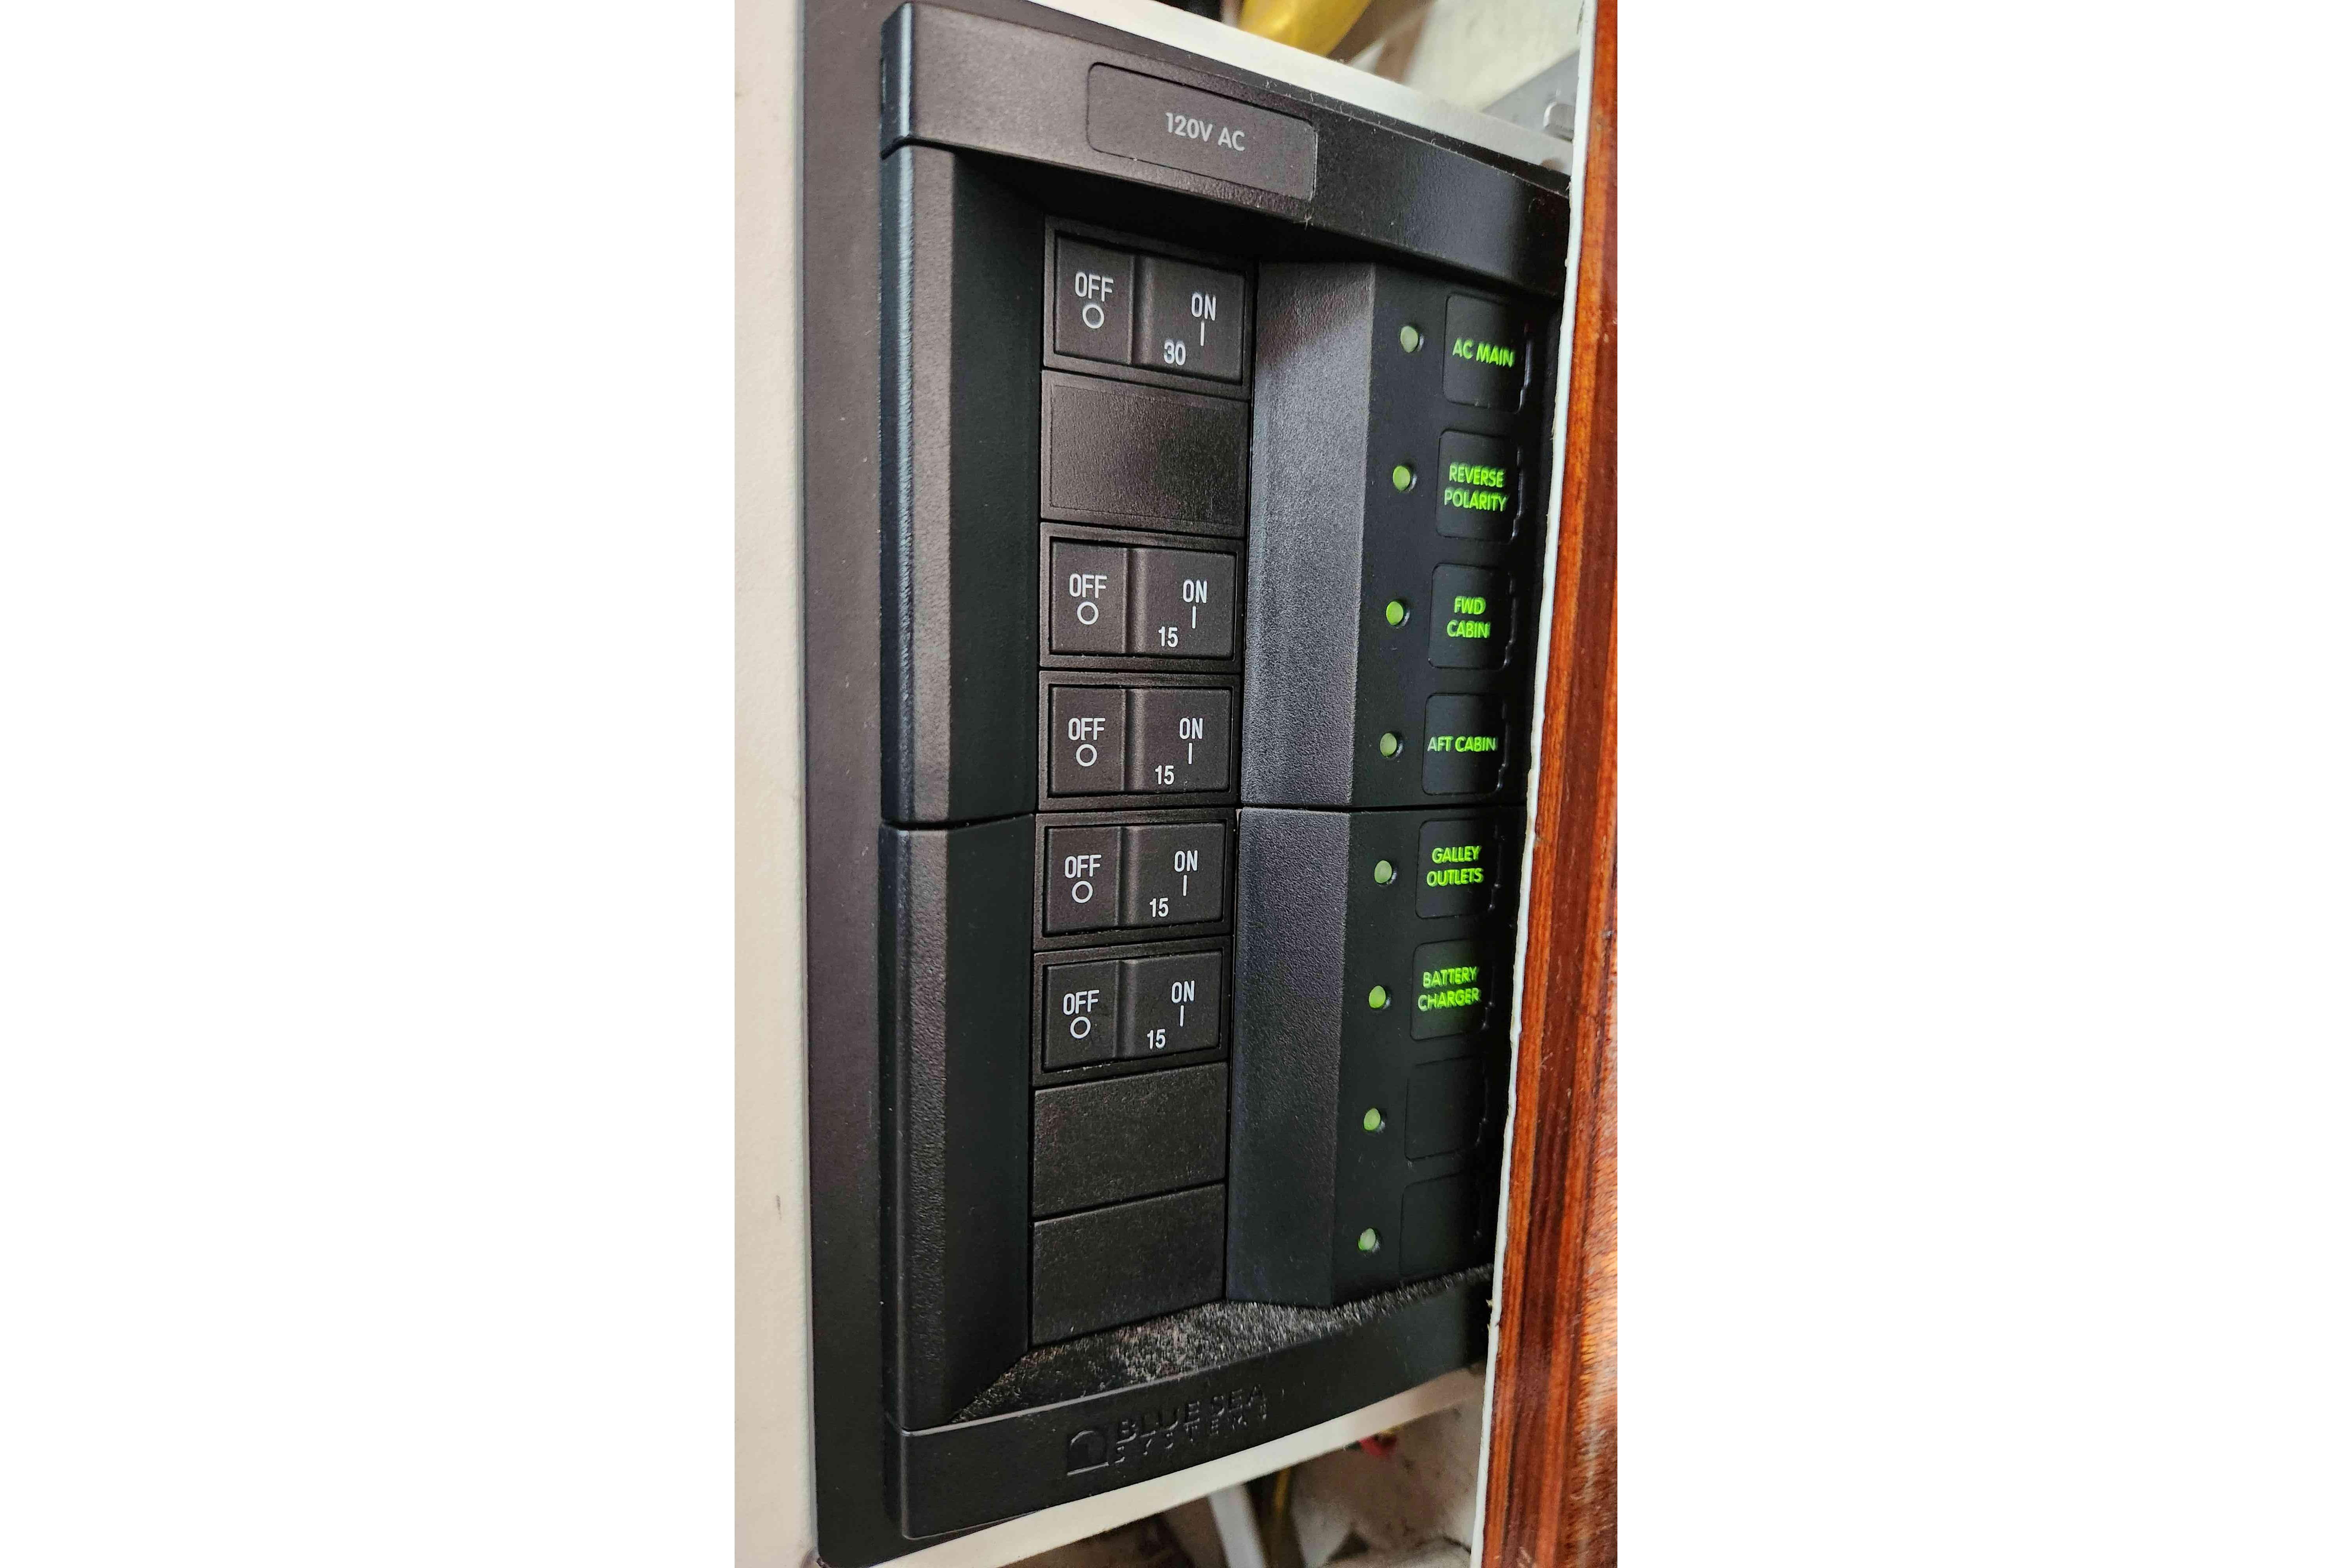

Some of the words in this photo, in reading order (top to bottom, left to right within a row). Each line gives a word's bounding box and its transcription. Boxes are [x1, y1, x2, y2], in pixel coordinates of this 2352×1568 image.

[1165, 112, 1213, 142] 120V
[1217, 127, 1245, 151] AC
[1074, 272, 1114, 302] OFF
[1191, 292, 1216, 321] ON
[1163, 339, 1186, 366] 30
[1452, 338, 1474, 359] AC
[1475, 343, 1514, 367] MAIN
[1448, 463, 1504, 488] REVERSE
[1444, 488, 1506, 512] POLARITY
[1069, 573, 1108, 599] OFF
[1182, 579, 1208, 604] ON
[1454, 595, 1485, 615] FWD
[1158, 626, 1179, 648] 15
[1446, 619, 1490, 638] CABIN
[1068, 717, 1106, 741] OFF
[1179, 717, 1203, 740] ON
[1427, 735, 1454, 752] AFT
[1454, 736, 1496, 753] CABIN
[1154, 764, 1175, 785] 15
[1064, 854, 1102, 879] OFF
[1174, 849, 1198, 873] ON
[1432, 845, 1481, 864] GALLEY
[1426, 867, 1483, 887] OUTLETS
[1149, 897, 1169, 918] 15
[1423, 966, 1477, 989] BATTERY
[1063, 989, 1100, 1016] OFF
[1171, 980, 1195, 1004] ON
[1417, 988, 1479, 1011] CHARGER
[1147, 1028, 1166, 1049] 15
[1116, 1400, 1200, 1444] BLUE
[1210, 1385, 1267, 1416] SEA
